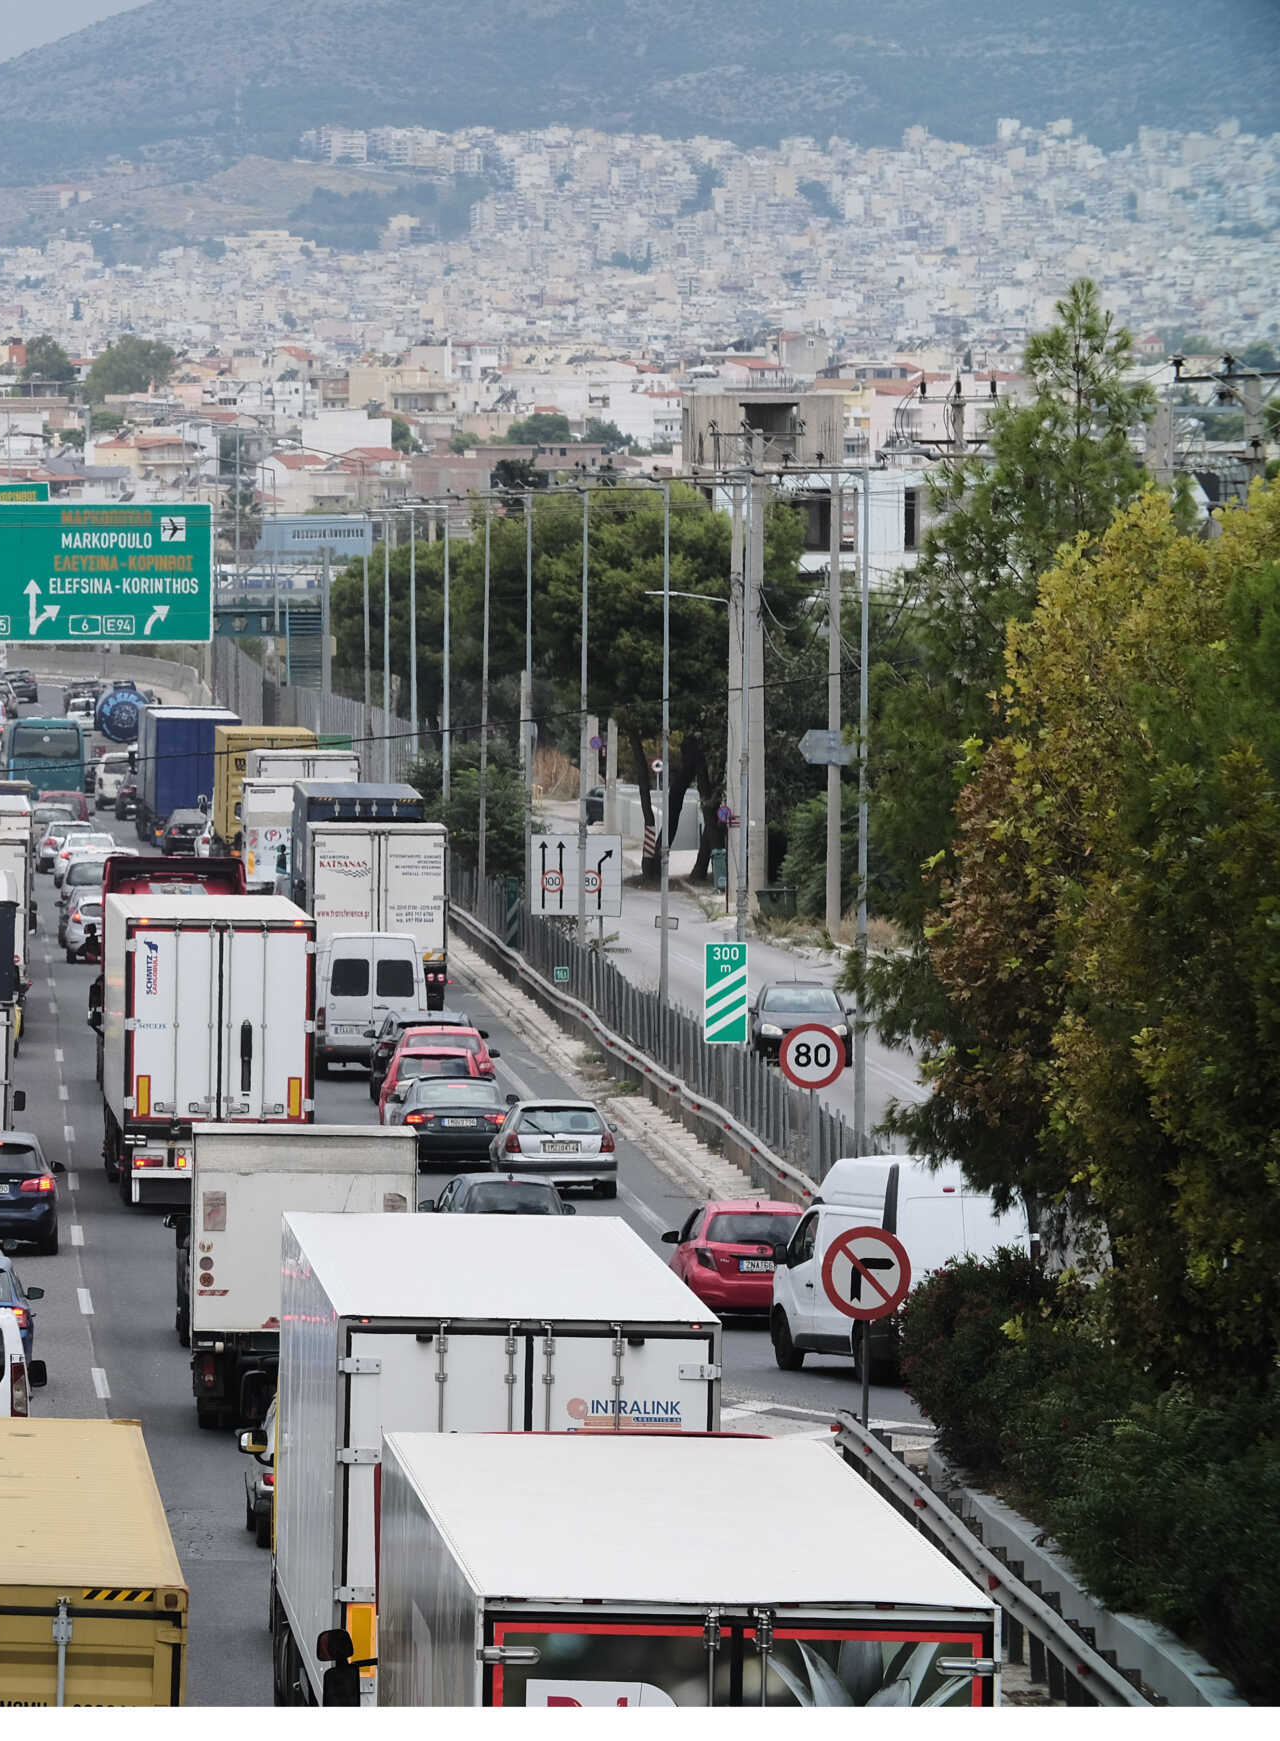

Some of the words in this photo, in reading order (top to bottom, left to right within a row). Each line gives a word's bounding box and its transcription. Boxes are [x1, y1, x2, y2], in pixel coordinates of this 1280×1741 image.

[61, 533, 152, 549] MARKOPOULO
[49, 578, 113, 594] ELEFSINA
[122, 578, 199, 594] KORINTHOS
[82, 619, 89, 631] 6
[107, 619, 131, 631] E94
[319, 860, 368, 868] KATSANAS
[545, 877, 561, 886] 100
[713, 947, 740, 960] 300
[720, 964, 731, 973] m
[794, 1043, 831, 1068] 80
[591, 1399, 680, 1415] INTRALINK
